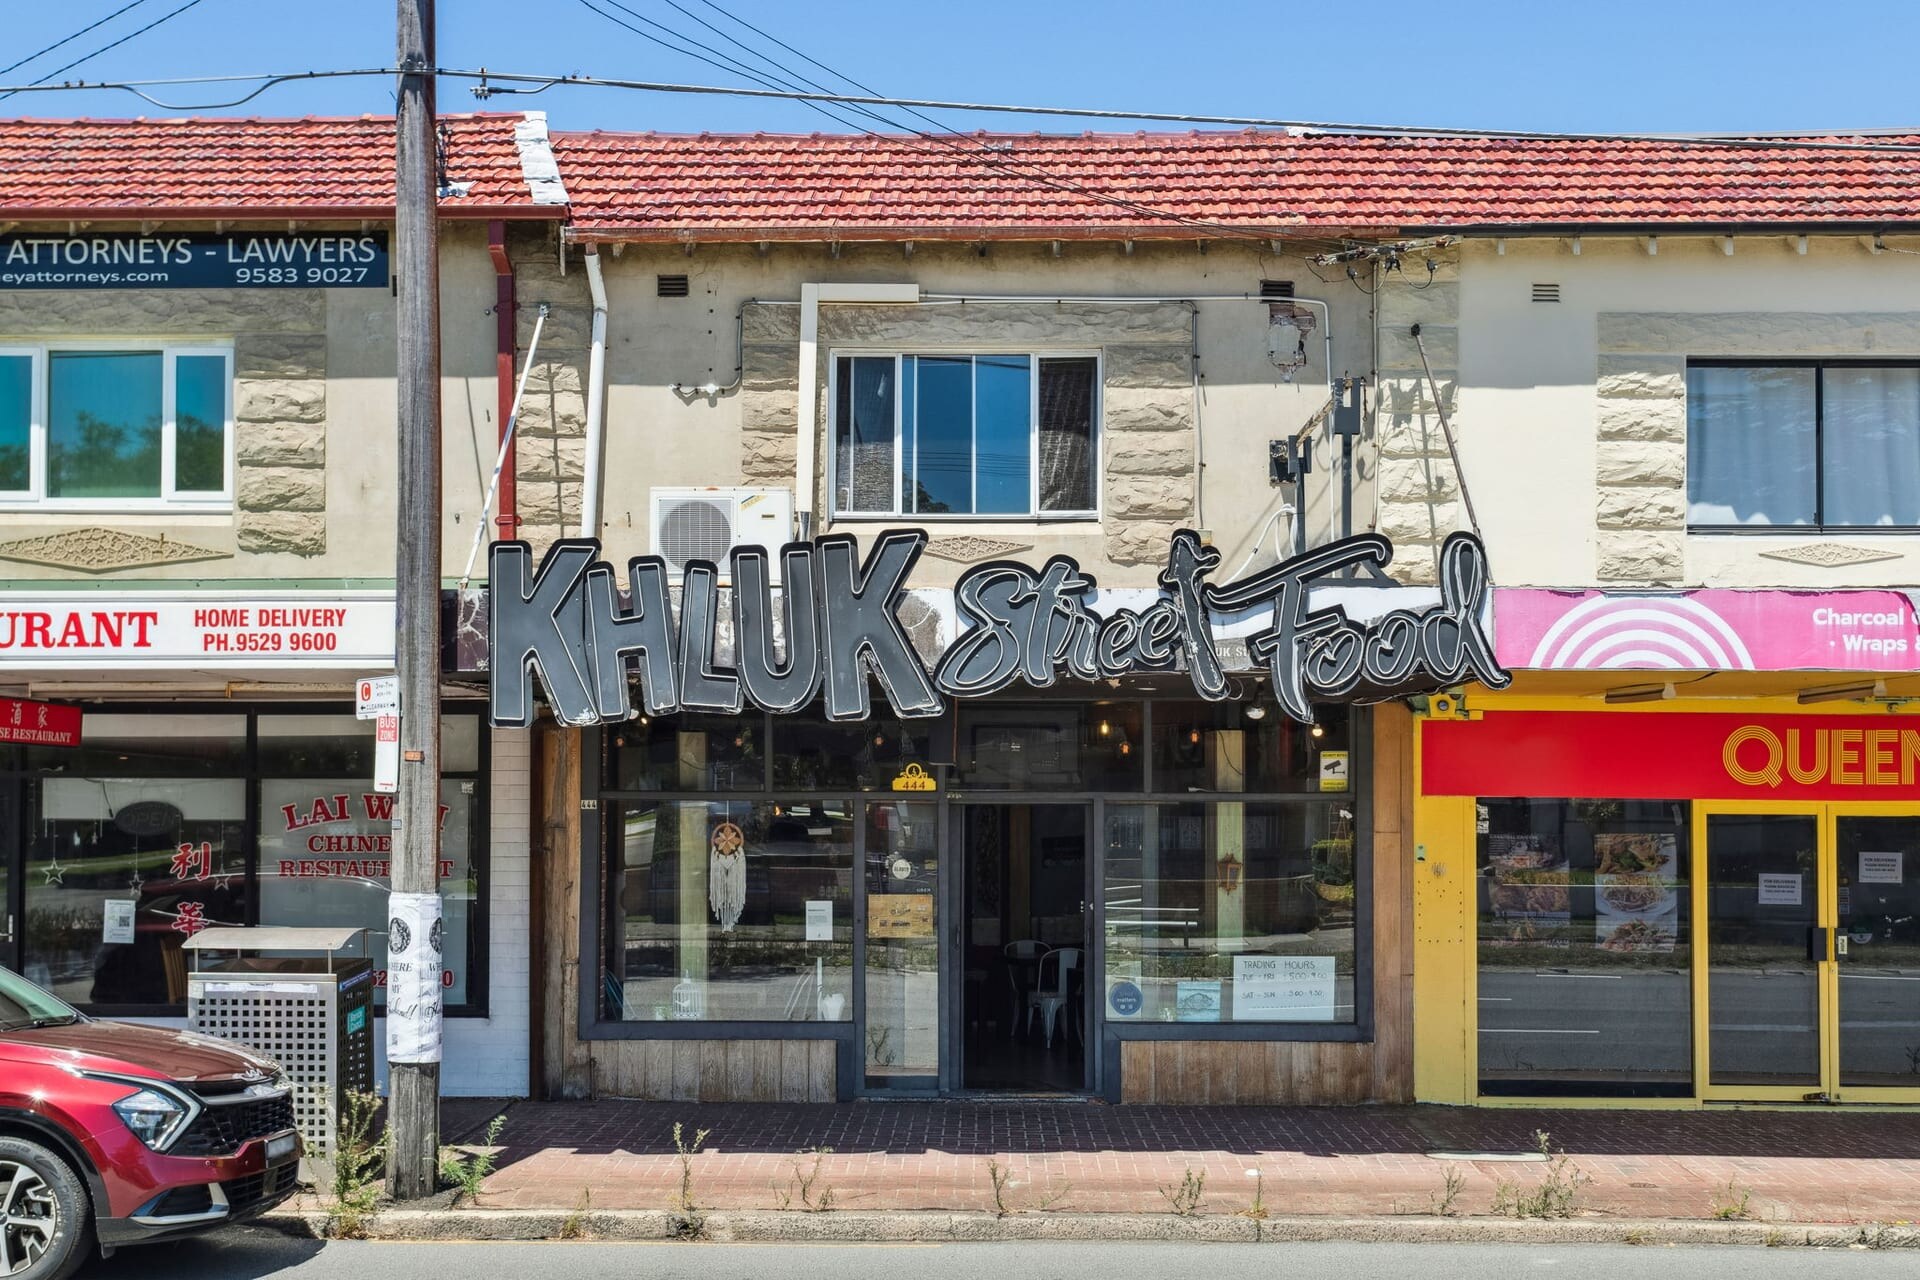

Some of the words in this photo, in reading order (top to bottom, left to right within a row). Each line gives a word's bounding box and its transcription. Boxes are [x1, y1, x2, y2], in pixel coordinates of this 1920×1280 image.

[6, 238, 192, 265] ATTORNEYS
[228, 238, 375, 263] LAWYERS
[0, 271, 169, 284] eyattorneys.com
[236, 267, 298, 283] 9583
[307, 267, 368, 283] 9027
[194, 608, 249, 627] HOME
[258, 608, 347, 627] DELIVERY
[1812, 607, 1904, 625] Charcoal
[488, 527, 949, 729] KHLUK
[931, 528, 1233, 701] Street
[1203, 530, 1513, 726] Food
[203, 633, 282, 651] PH.9529
[289, 633, 337, 651] 9600
[1842, 634, 1908, 656] Wraps
[361, 682, 371, 701] C
[380, 717, 396, 728] BUS
[12, 727, 73, 743] RESTAURANT
[380, 730, 396, 741] ZONE
[902, 780, 926, 790] 444
[278, 793, 350, 832] LAI
[307, 834, 391, 854] CHINE
[278, 859, 454, 878] RESTAURT
[1244, 961, 1276, 969] TRADING
[1284, 961, 1316, 970] HOURS
